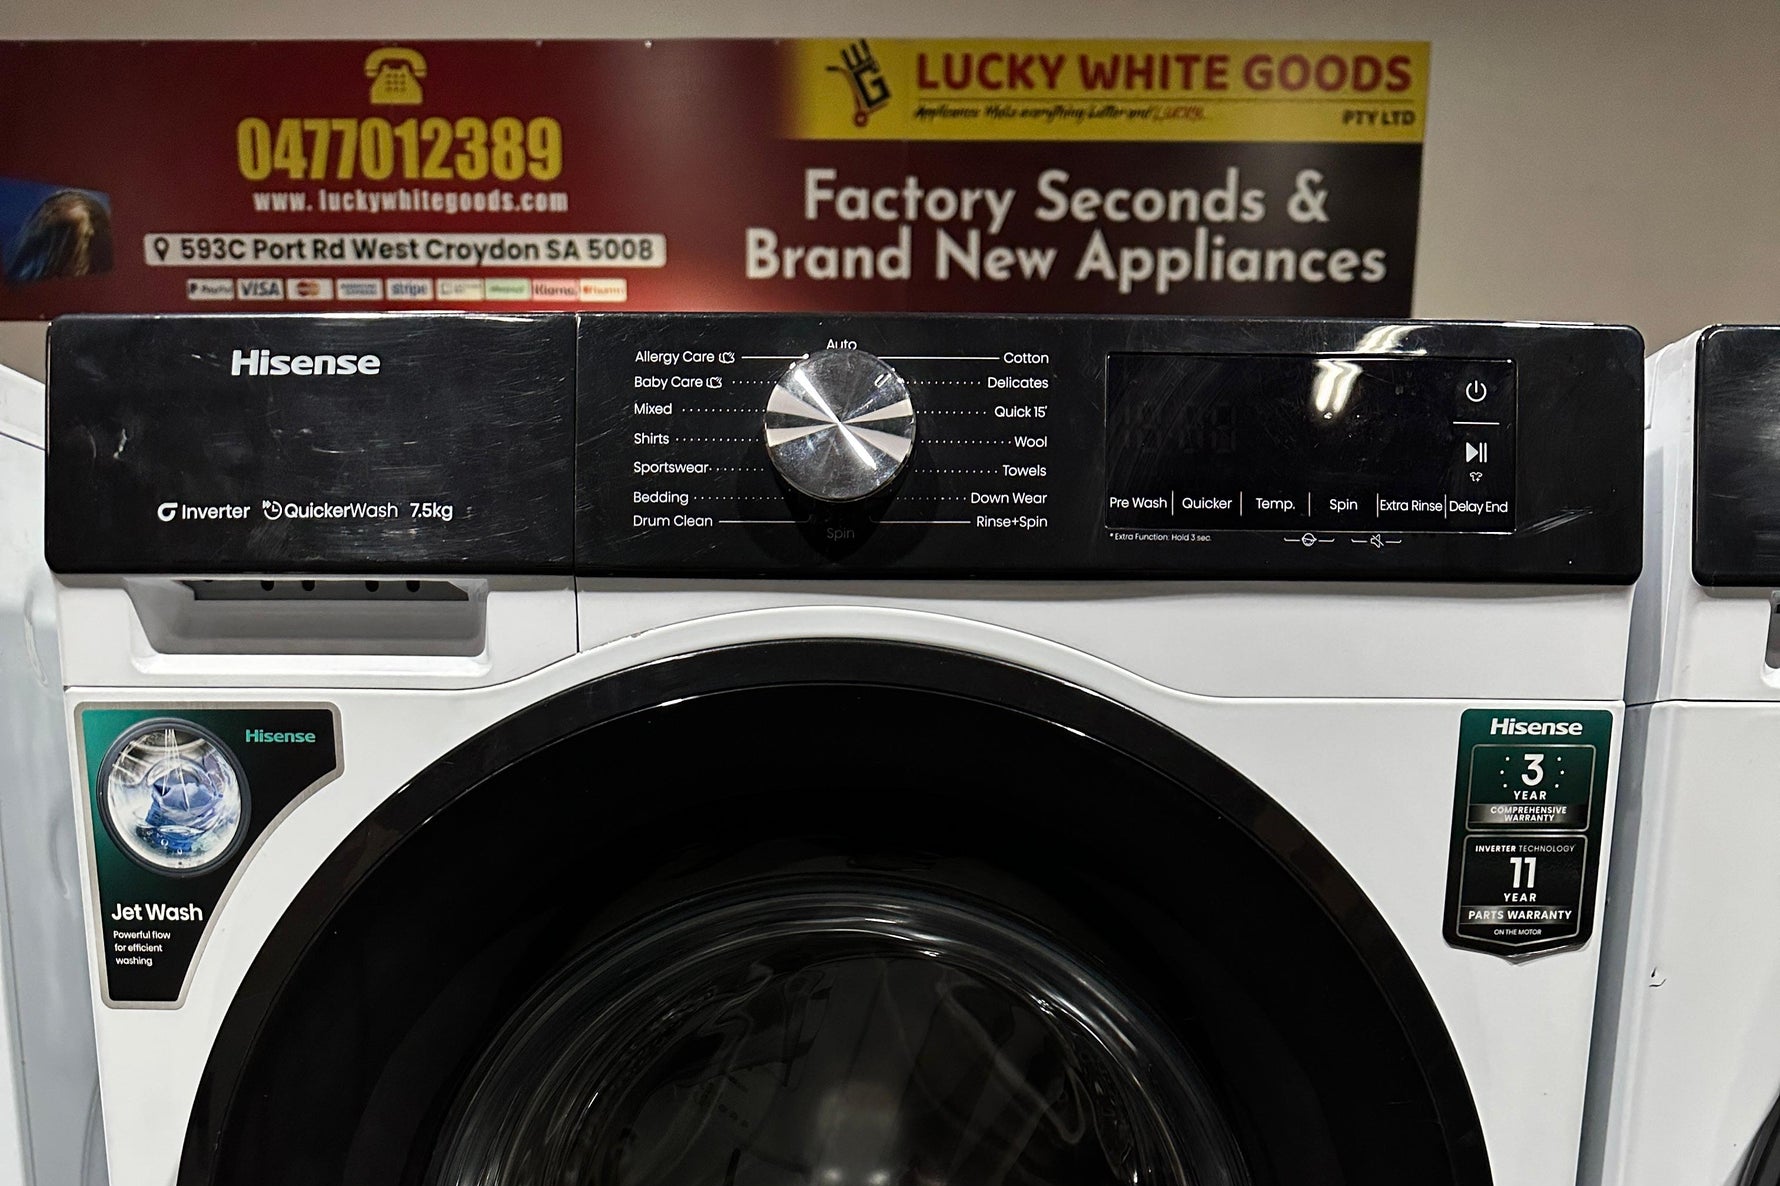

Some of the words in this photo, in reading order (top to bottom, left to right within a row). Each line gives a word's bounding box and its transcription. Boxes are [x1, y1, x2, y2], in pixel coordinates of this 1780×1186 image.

[915, 52, 1066, 91] LUCKY
[1078, 53, 1229, 92] WHITE
[1243, 54, 1413, 94] GOODS
[1343, 110, 1378, 127] PTY
[1382, 111, 1416, 127] LTD
[237, 116, 564, 181] 0477012389
[318, 188, 569, 214] luckywhitegoods.com
[804, 167, 1016, 234] Factory
[1035, 166, 1267, 223] Seconds
[1287, 168, 1331, 223] &
[180, 238, 246, 261] 593C
[253, 238, 308, 261] Port
[313, 238, 346, 260] Rd
[351, 238, 423, 261] West
[425, 238, 540, 267] Croydon
[547, 239, 580, 261] SA
[587, 239, 654, 261] 5008
[744, 226, 912, 281] Brand
[936, 229, 1058, 281] New
[1075, 226, 1388, 295] Appliances
[239, 281, 280, 297] VISA
[390, 282, 429, 297] stripe
[230, 349, 381, 376] Hisense
[635, 351, 680, 365] Allergy
[682, 351, 715, 363] Care
[1003, 352, 1049, 364] Cotton
[634, 376, 668, 390] Baby
[670, 376, 703, 388] Care
[987, 377, 1049, 389] Delicates
[634, 403, 673, 415] Mixed
[994, 406, 1031, 419] Quick
[634, 433, 670, 445] Shirts
[1014, 436, 1048, 448] Wool
[633, 461, 709, 476] Sportswear
[1002, 465, 1047, 477] Towels
[633, 491, 689, 506] Bedding
[970, 492, 1008, 504] Down
[1011, 492, 1048, 504] Wear
[1109, 497, 1131, 508] Pre
[1132, 497, 1168, 509] Wash
[1182, 497, 1233, 510] Quicker
[1255, 498, 1296, 512] Temp.
[182, 504, 251, 520] Inverter
[284, 502, 399, 520] QuickerWash
[410, 502, 454, 521] 7.5kg
[1329, 499, 1358, 512] Spin
[1379, 500, 1408, 512] Extra
[1410, 500, 1443, 512] Rinse
[1449, 501, 1482, 515] Delay
[1483, 501, 1508, 513] End
[633, 515, 669, 527] Drum
[671, 515, 713, 527] Clean
[976, 515, 1048, 530] Rinse+Spin
[826, 527, 855, 541] Spin
[1171, 533, 1190, 541] Hold
[1490, 718, 1584, 736] Hisense
[245, 728, 316, 743] Hisense
[1521, 753, 1545, 787] 3
[1513, 790, 1547, 801] YEAR
[1490, 806, 1568, 815] COMPREHENSIVE
[1504, 813, 1556, 822] WARRANTY
[1475, 844, 1516, 853] INVERTER
[1517, 844, 1577, 853] TECHNOLOGY
[1509, 856, 1537, 889] 11
[1503, 892, 1537, 903] YEAR
[111, 903, 143, 922] Jet
[144, 903, 204, 922] Wash
[1468, 910, 1505, 920] PARTS
[1507, 910, 1573, 921] WARRANTY
[113, 930, 151, 940] Powerful
[151, 930, 171, 940] flow
[1494, 928, 1506, 936] ON
[1505, 928, 1517, 936] THE
[1517, 929, 1543, 937] MOTOR
[114, 943, 127, 953] for
[127, 943, 163, 953] efficient
[115, 956, 153, 967] washing
